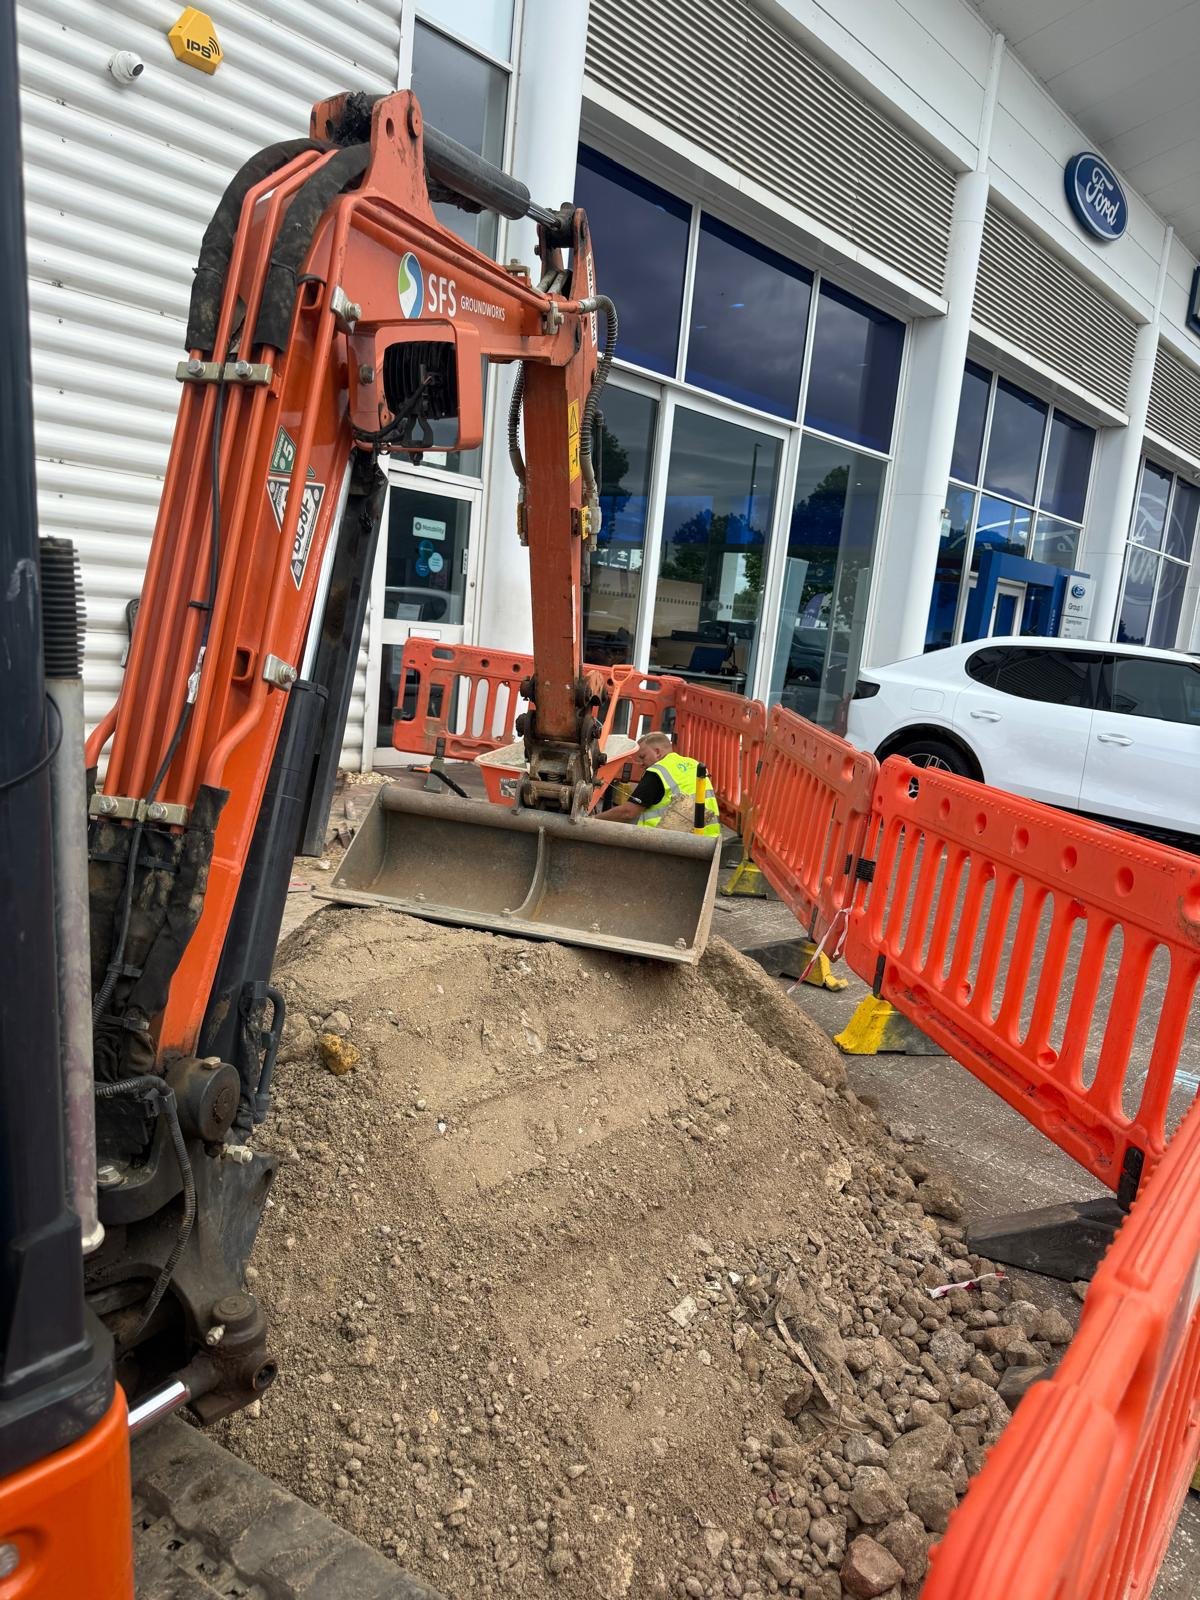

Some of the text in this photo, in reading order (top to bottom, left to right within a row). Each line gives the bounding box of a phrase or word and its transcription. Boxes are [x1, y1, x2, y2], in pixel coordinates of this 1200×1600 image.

[186, 38, 211, 59] IPS
[1085, 166, 1121, 227] Ford
[427, 272, 506, 322] SFS GROUNDWORKS
